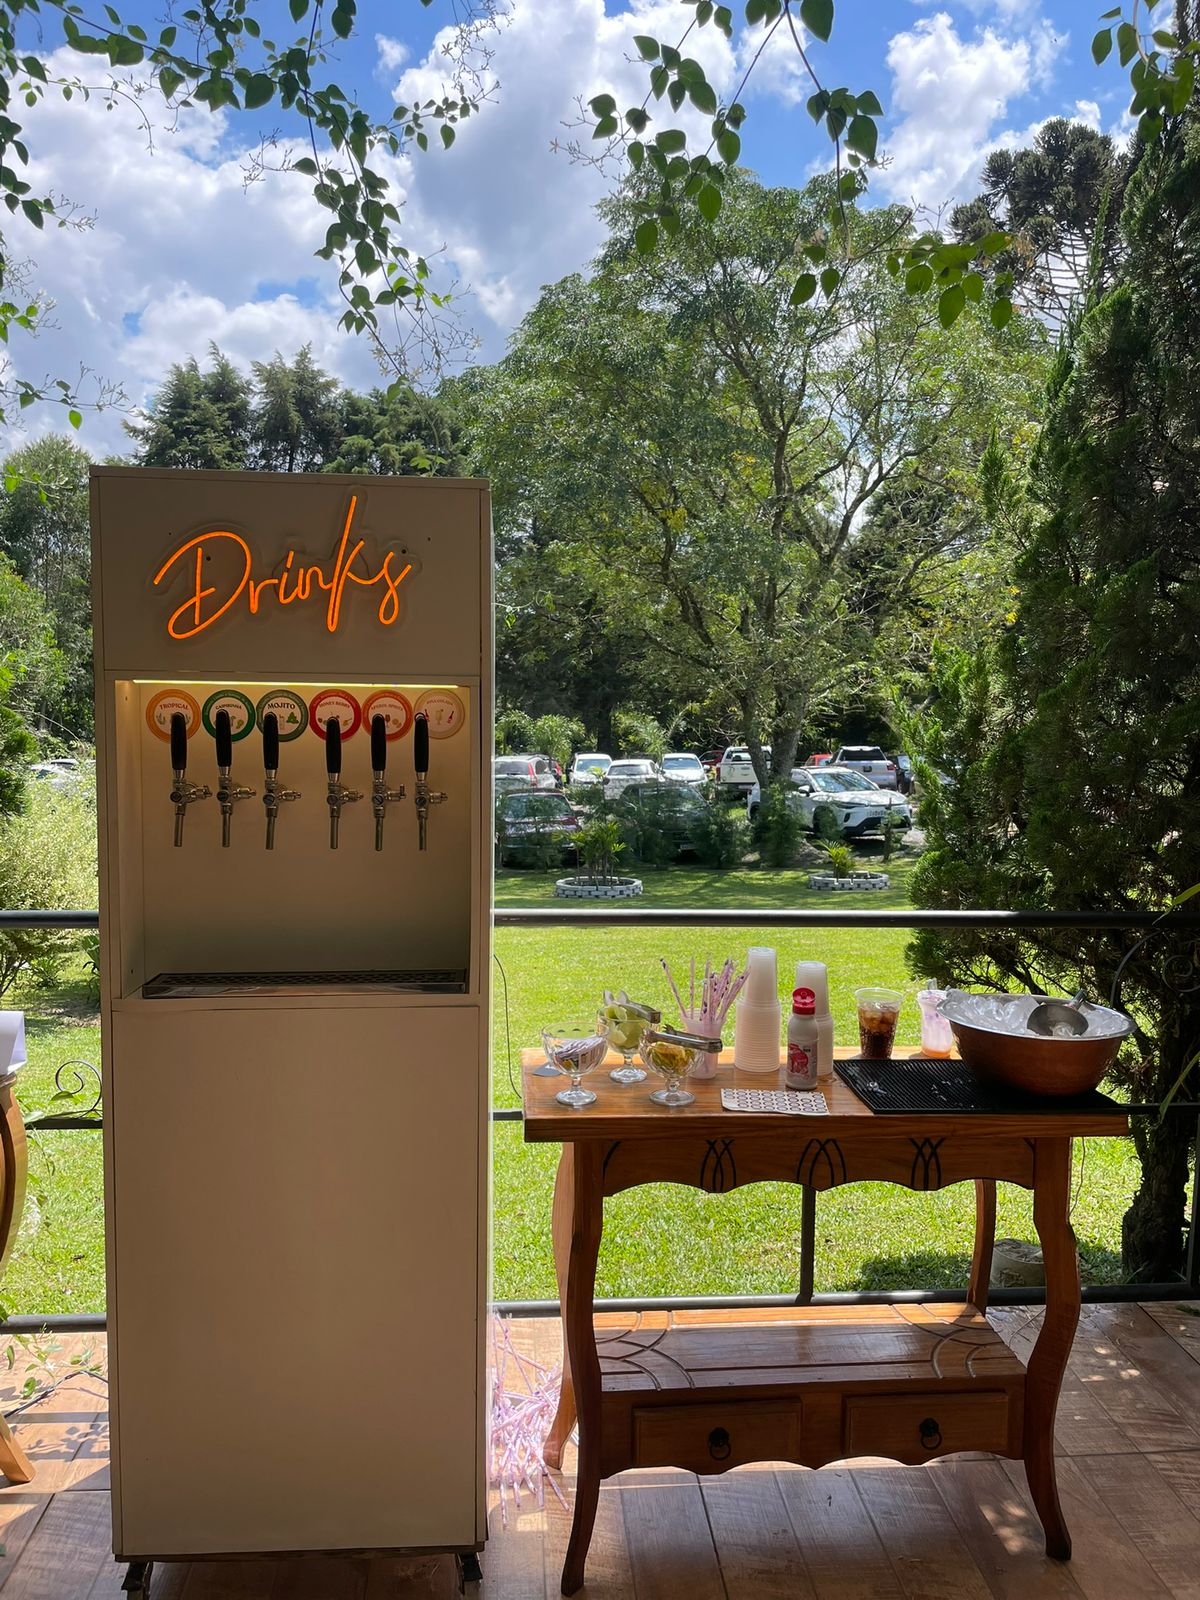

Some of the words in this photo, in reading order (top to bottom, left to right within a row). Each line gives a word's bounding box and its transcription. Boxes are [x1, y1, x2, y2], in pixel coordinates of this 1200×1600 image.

[153, 495, 413, 640] Drinks
[159, 702, 189, 711] TROPICAL
[267, 702, 296, 710] MOJITO
